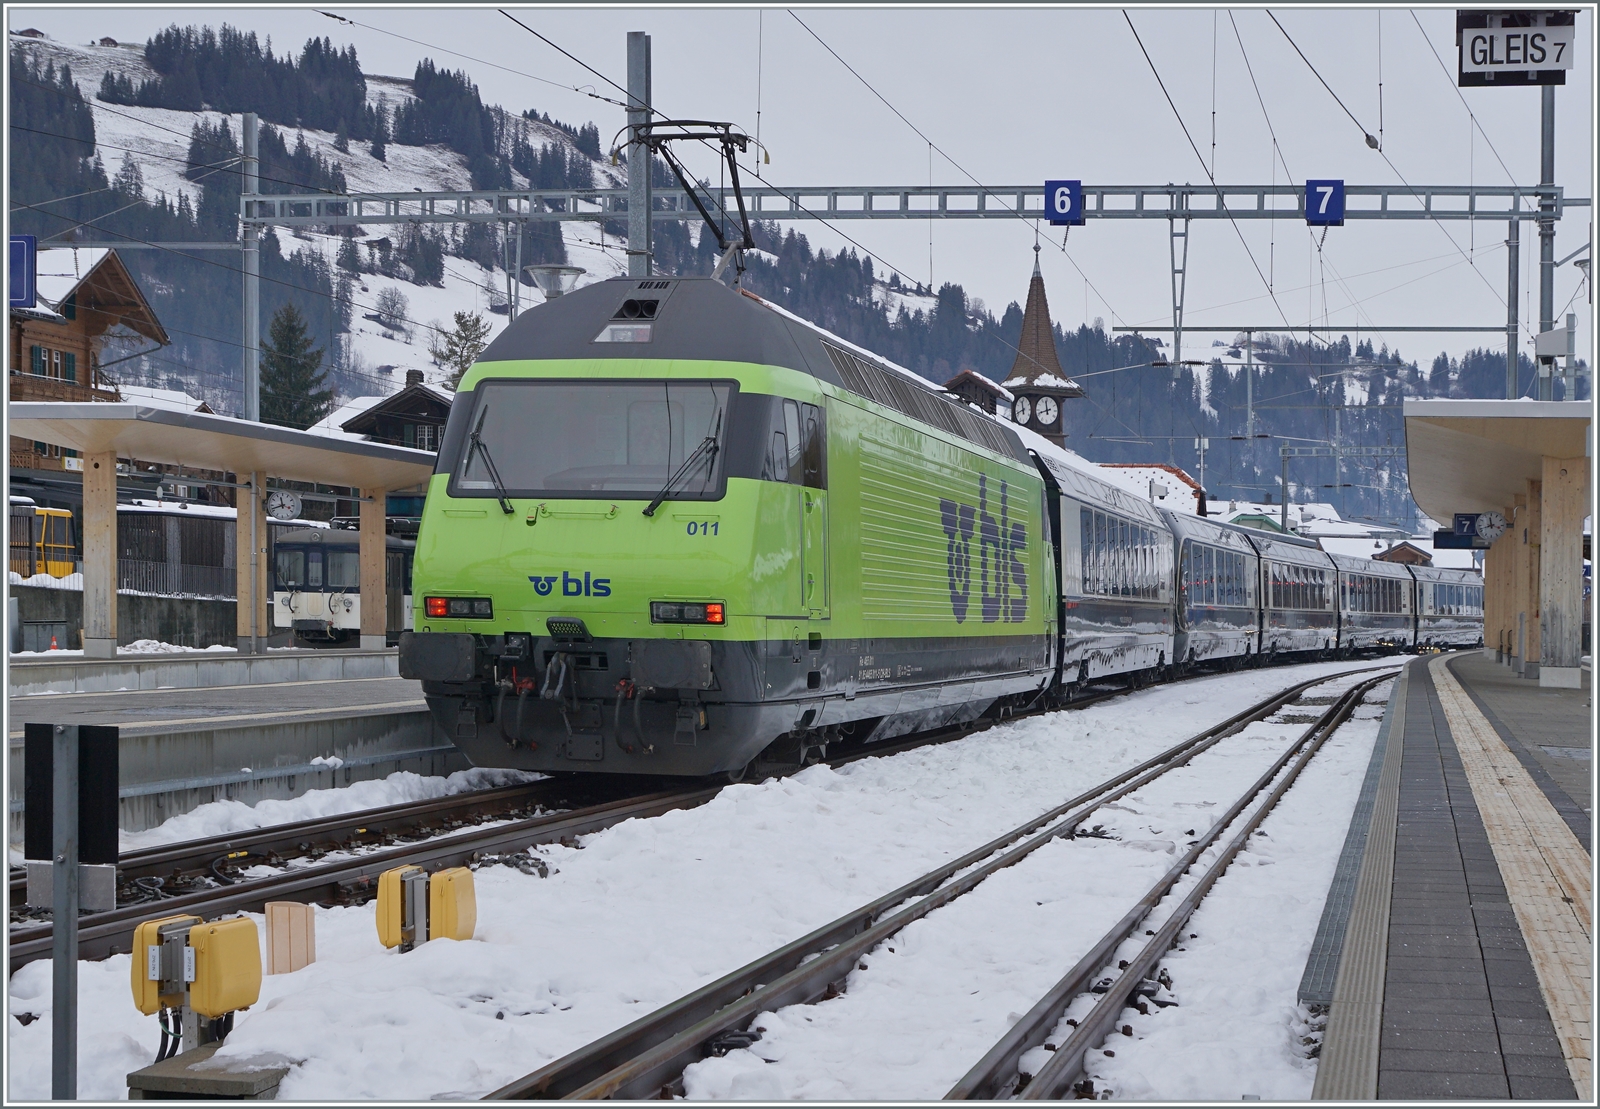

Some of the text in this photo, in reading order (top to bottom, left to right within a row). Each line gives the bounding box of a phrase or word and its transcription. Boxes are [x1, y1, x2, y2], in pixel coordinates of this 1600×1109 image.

[1470, 33, 1567, 66] GLEIS 7
[1054, 186, 1071, 214] 6
[1316, 186, 1334, 214] 7
[686, 521, 719, 536] 011
[1462, 520, 1470, 533] 7
[978, 471, 1028, 624] bls
[562, 570, 612, 597] bls
